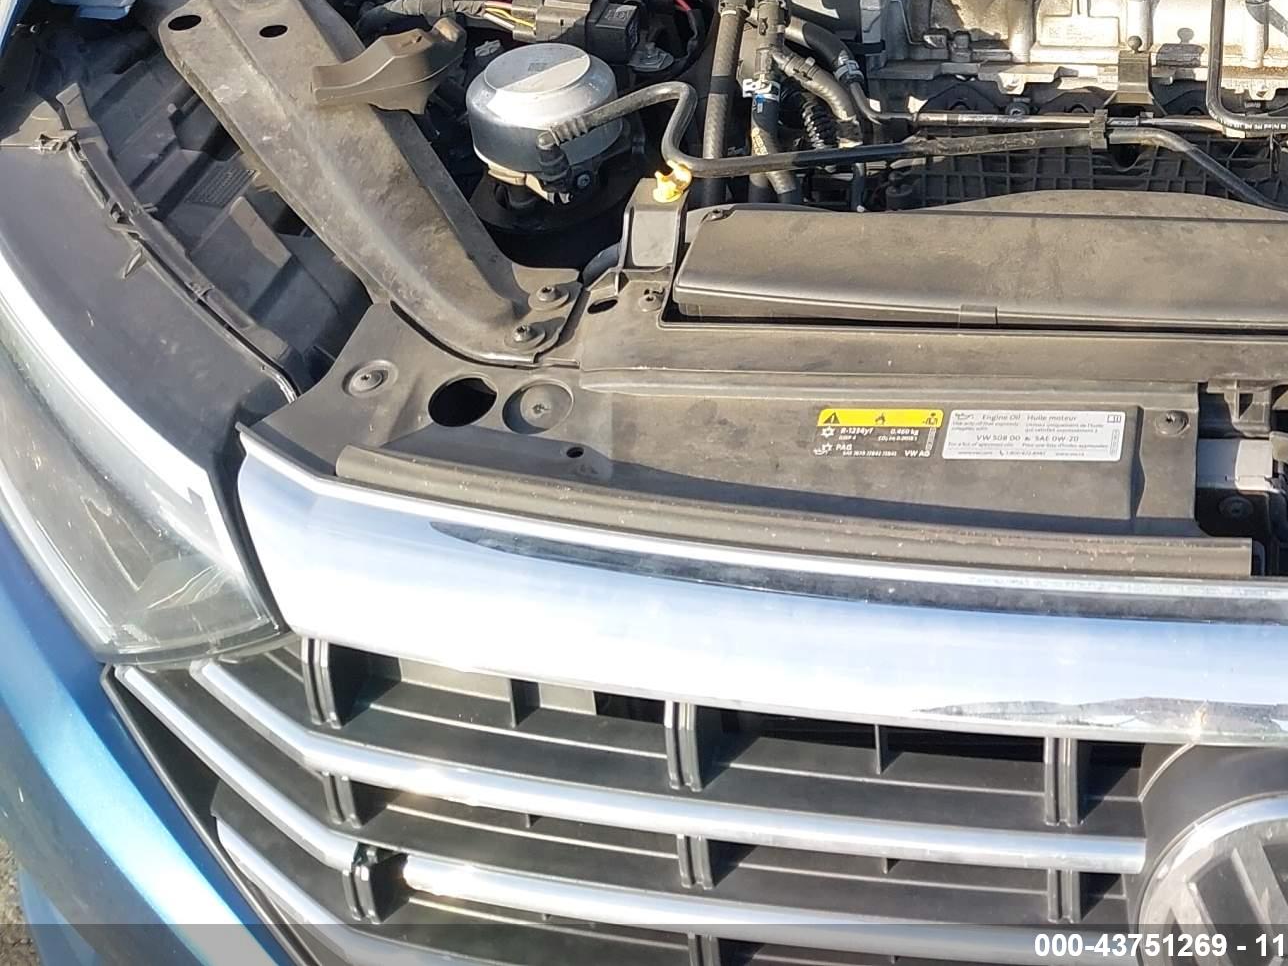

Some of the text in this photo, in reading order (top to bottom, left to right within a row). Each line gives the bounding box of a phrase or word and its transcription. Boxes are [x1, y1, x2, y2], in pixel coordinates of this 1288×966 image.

[982, 414, 1007, 423] Engine
[1009, 413, 1021, 421] Oil
[1026, 414, 1047, 422] Huile
[976, 434, 992, 442] VW
[836, 443, 853, 451] PAG
[904, 449, 918, 457] VW
